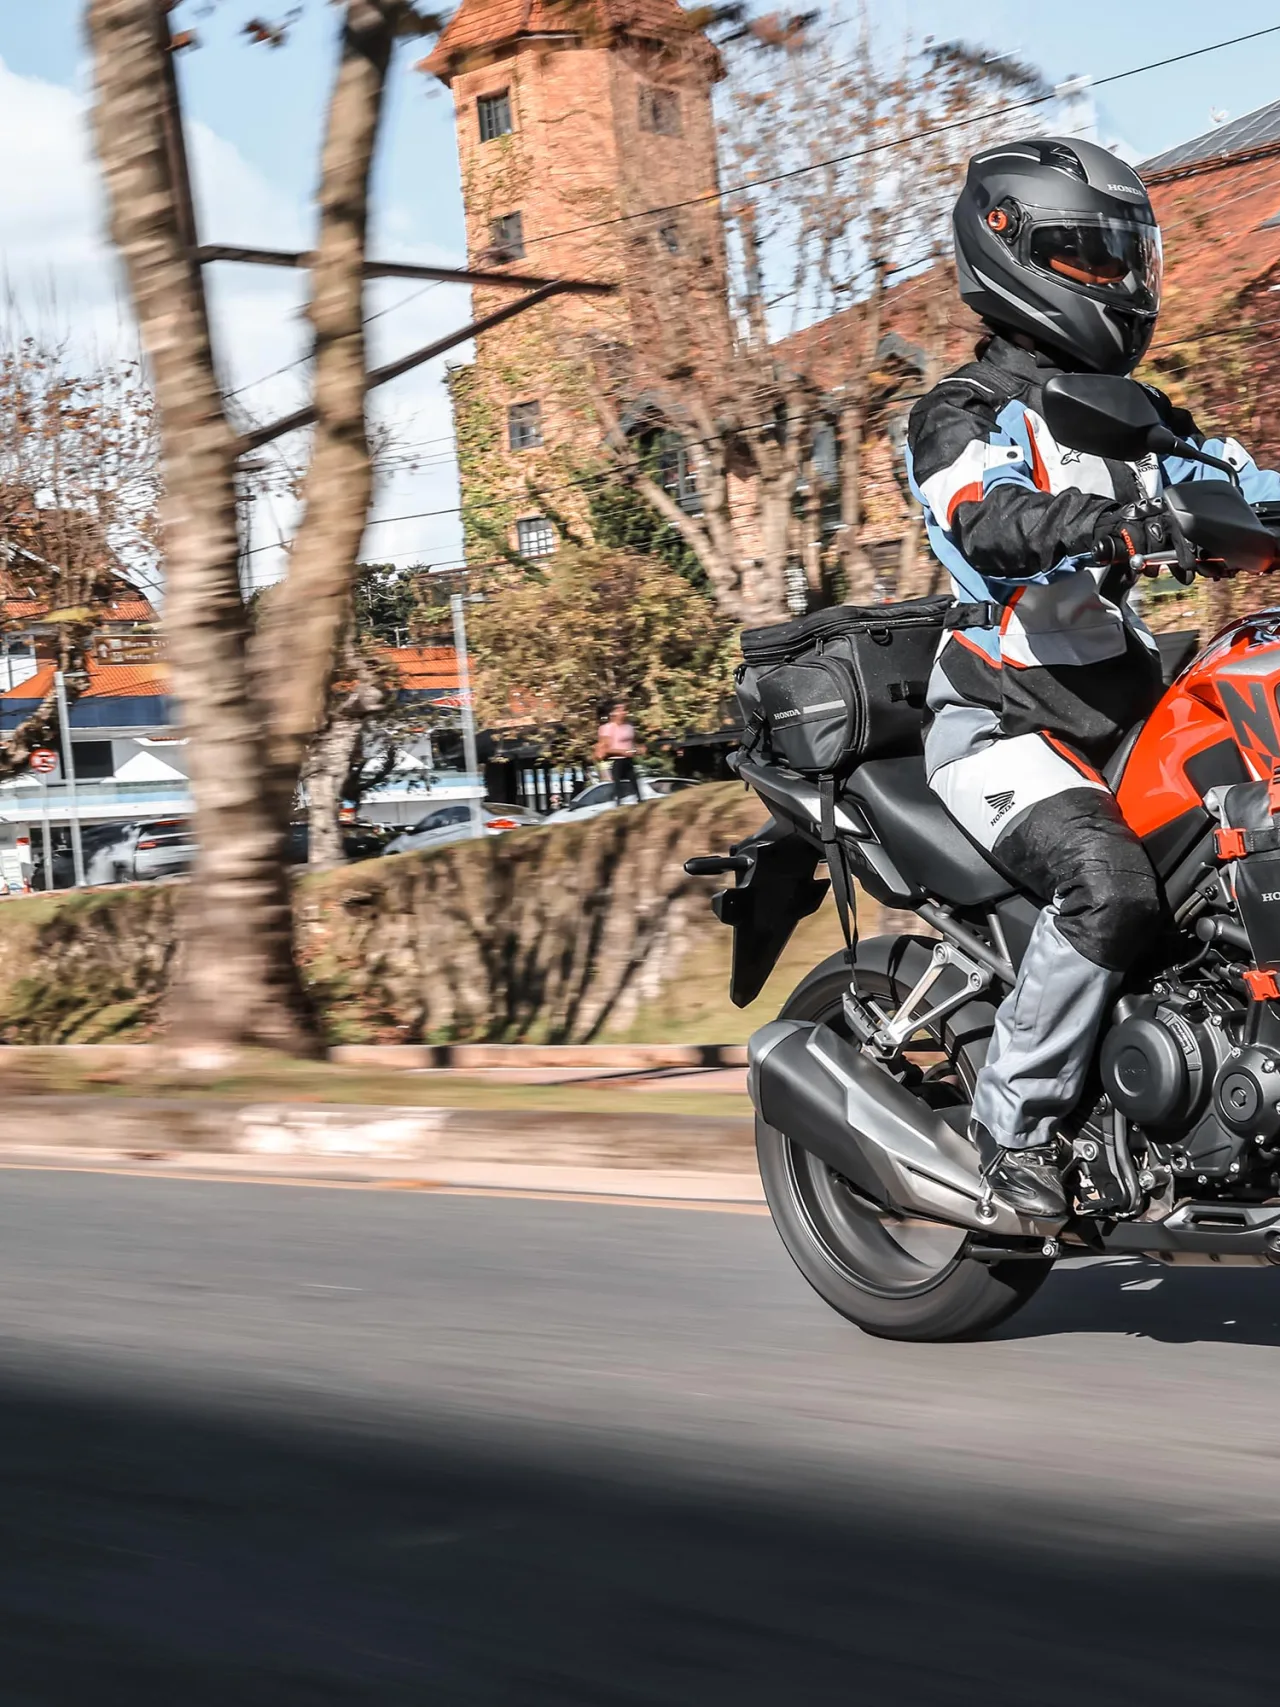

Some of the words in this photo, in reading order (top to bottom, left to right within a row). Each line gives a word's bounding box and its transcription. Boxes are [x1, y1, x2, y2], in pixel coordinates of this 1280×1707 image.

[1107, 183, 1145, 197] HONDA
[1121, 529, 1136, 556] HOND
[774, 709, 801, 720] HONDA
[990, 802, 1015, 827] HONDA
